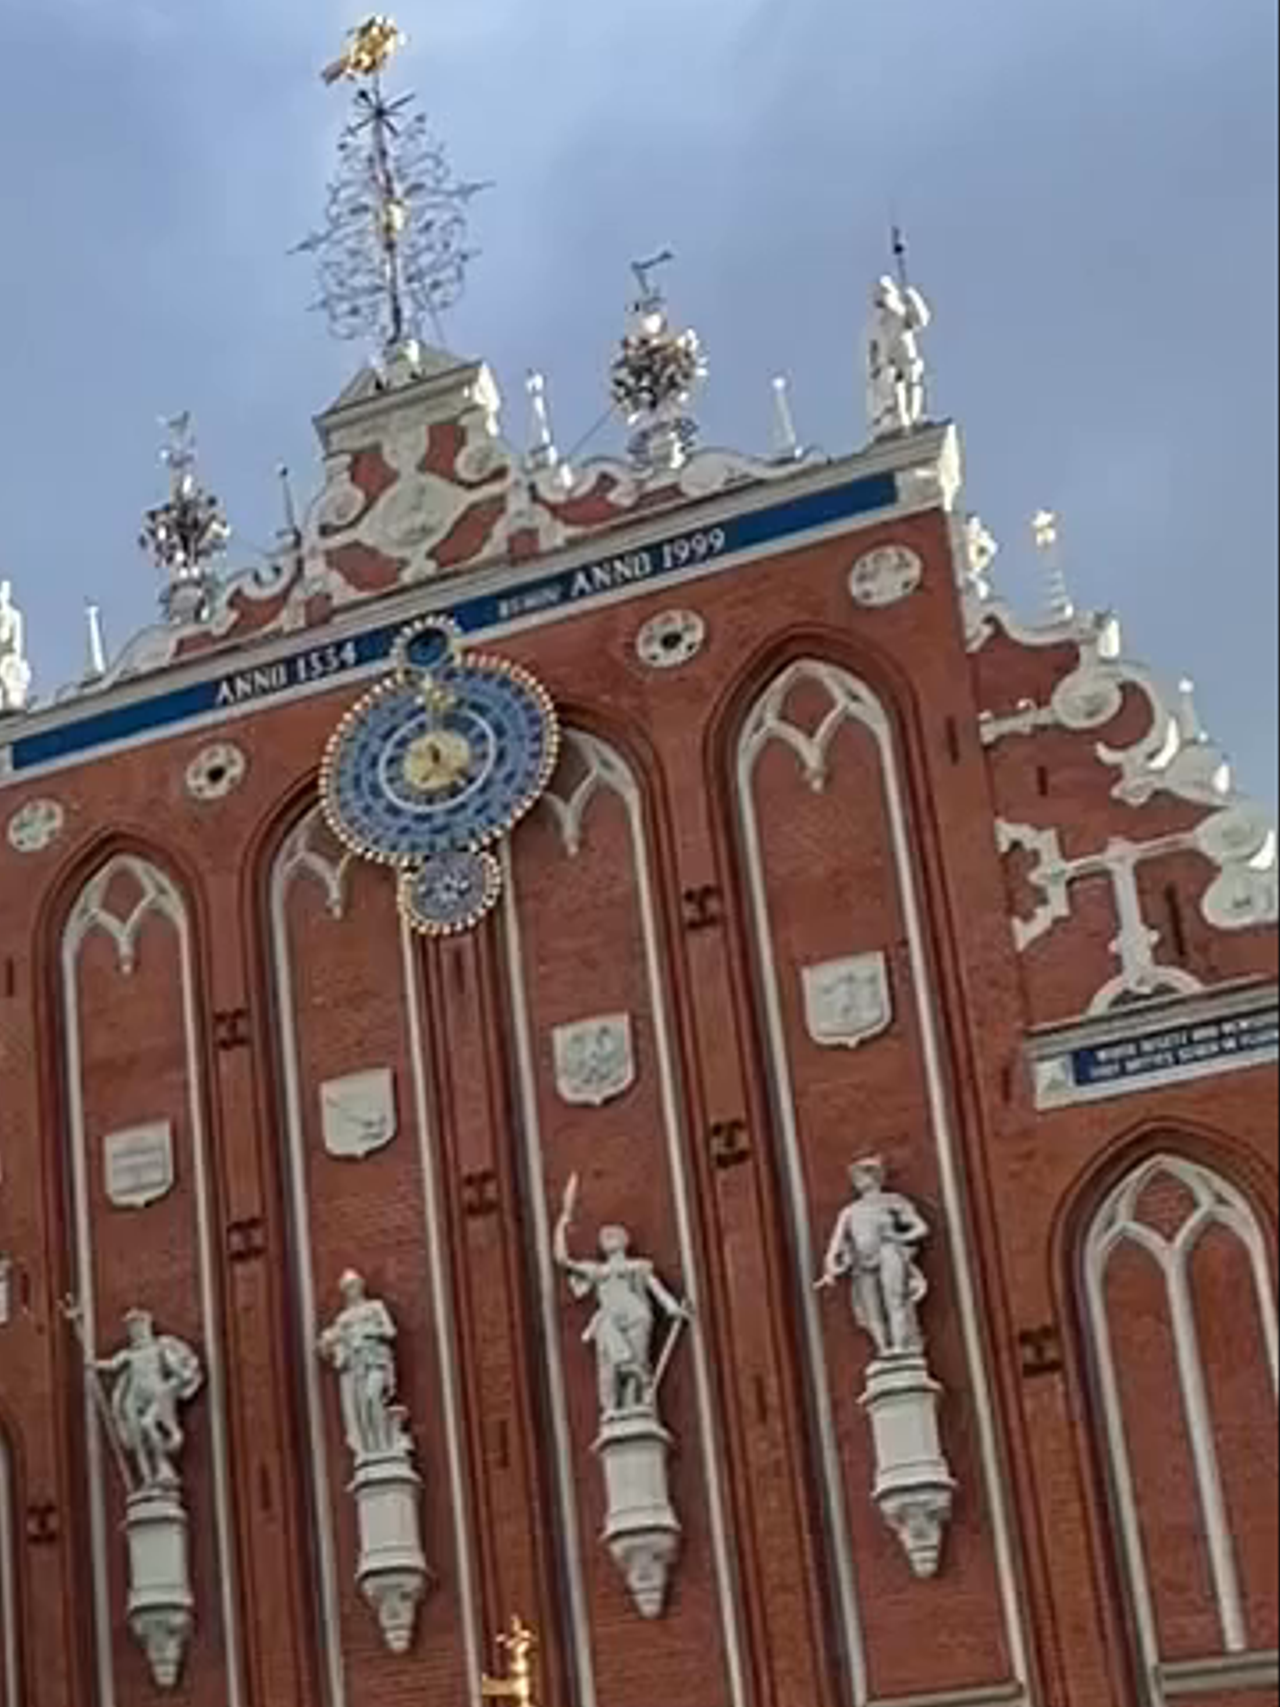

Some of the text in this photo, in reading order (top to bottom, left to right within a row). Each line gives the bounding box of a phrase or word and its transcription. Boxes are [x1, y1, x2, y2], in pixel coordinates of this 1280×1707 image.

[214, 664, 288, 706] ANNO
[570, 553, 652, 598] ANNO
[661, 527, 726, 570] 1999
